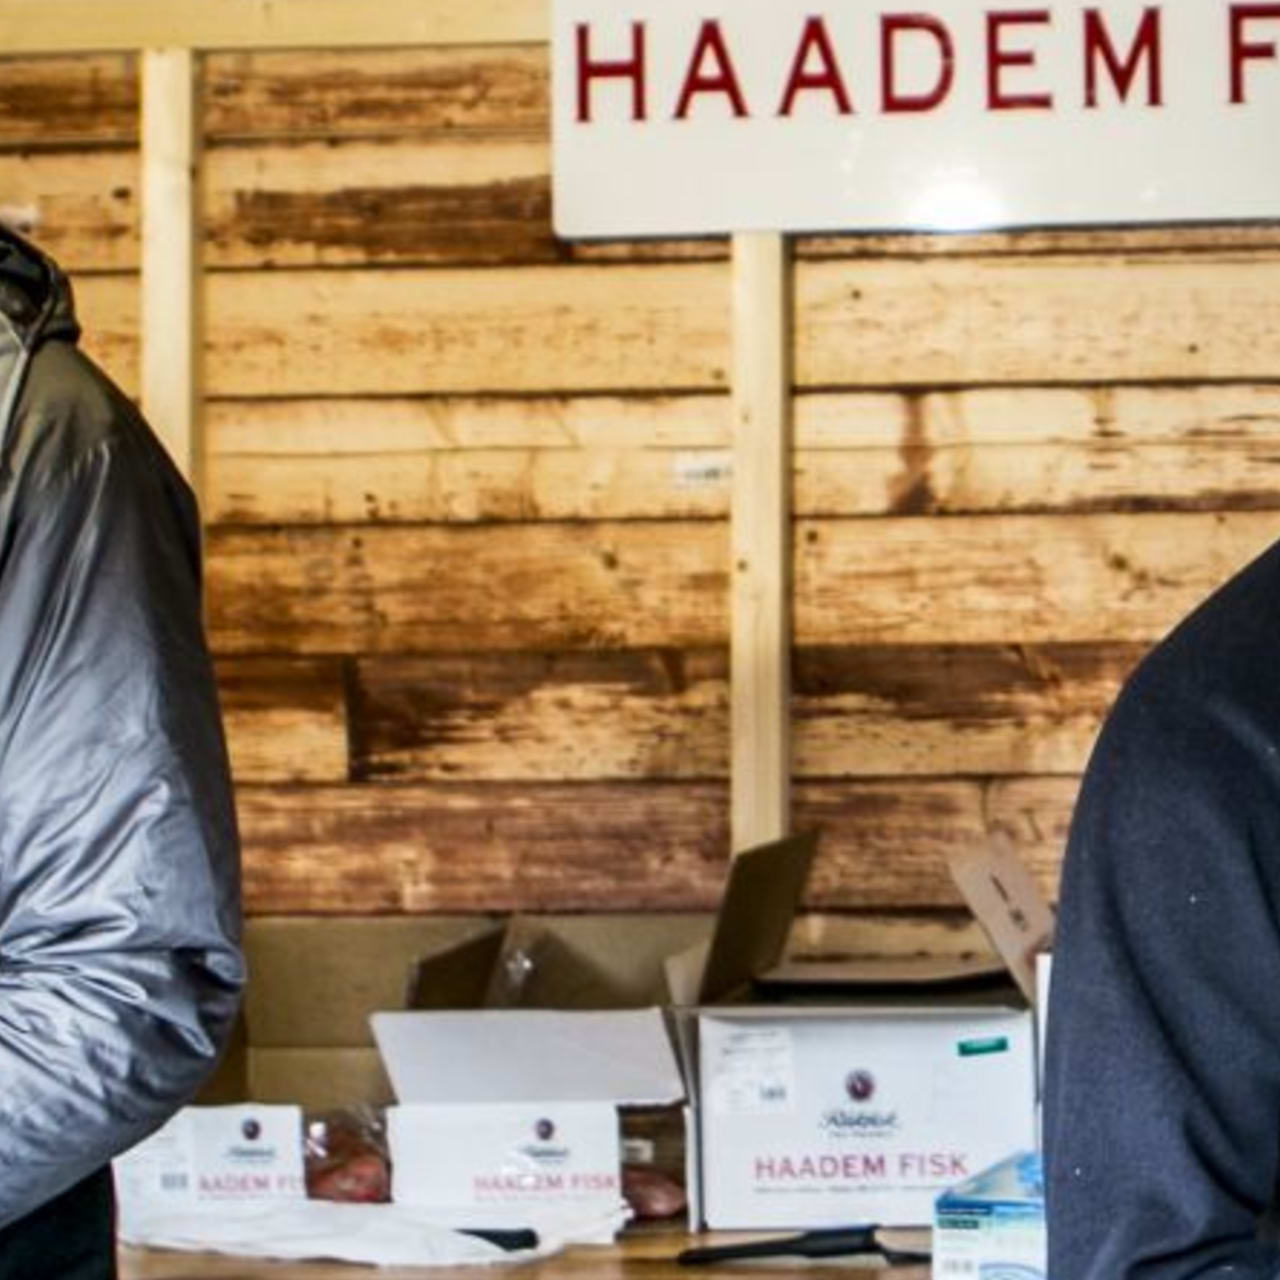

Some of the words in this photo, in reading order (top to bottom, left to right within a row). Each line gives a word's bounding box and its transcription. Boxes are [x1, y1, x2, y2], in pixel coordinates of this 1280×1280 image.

[574, 5, 1164, 122] HAADEM
[753, 1153, 887, 1179] HAADEM
[898, 1152, 969, 1176] FISK
